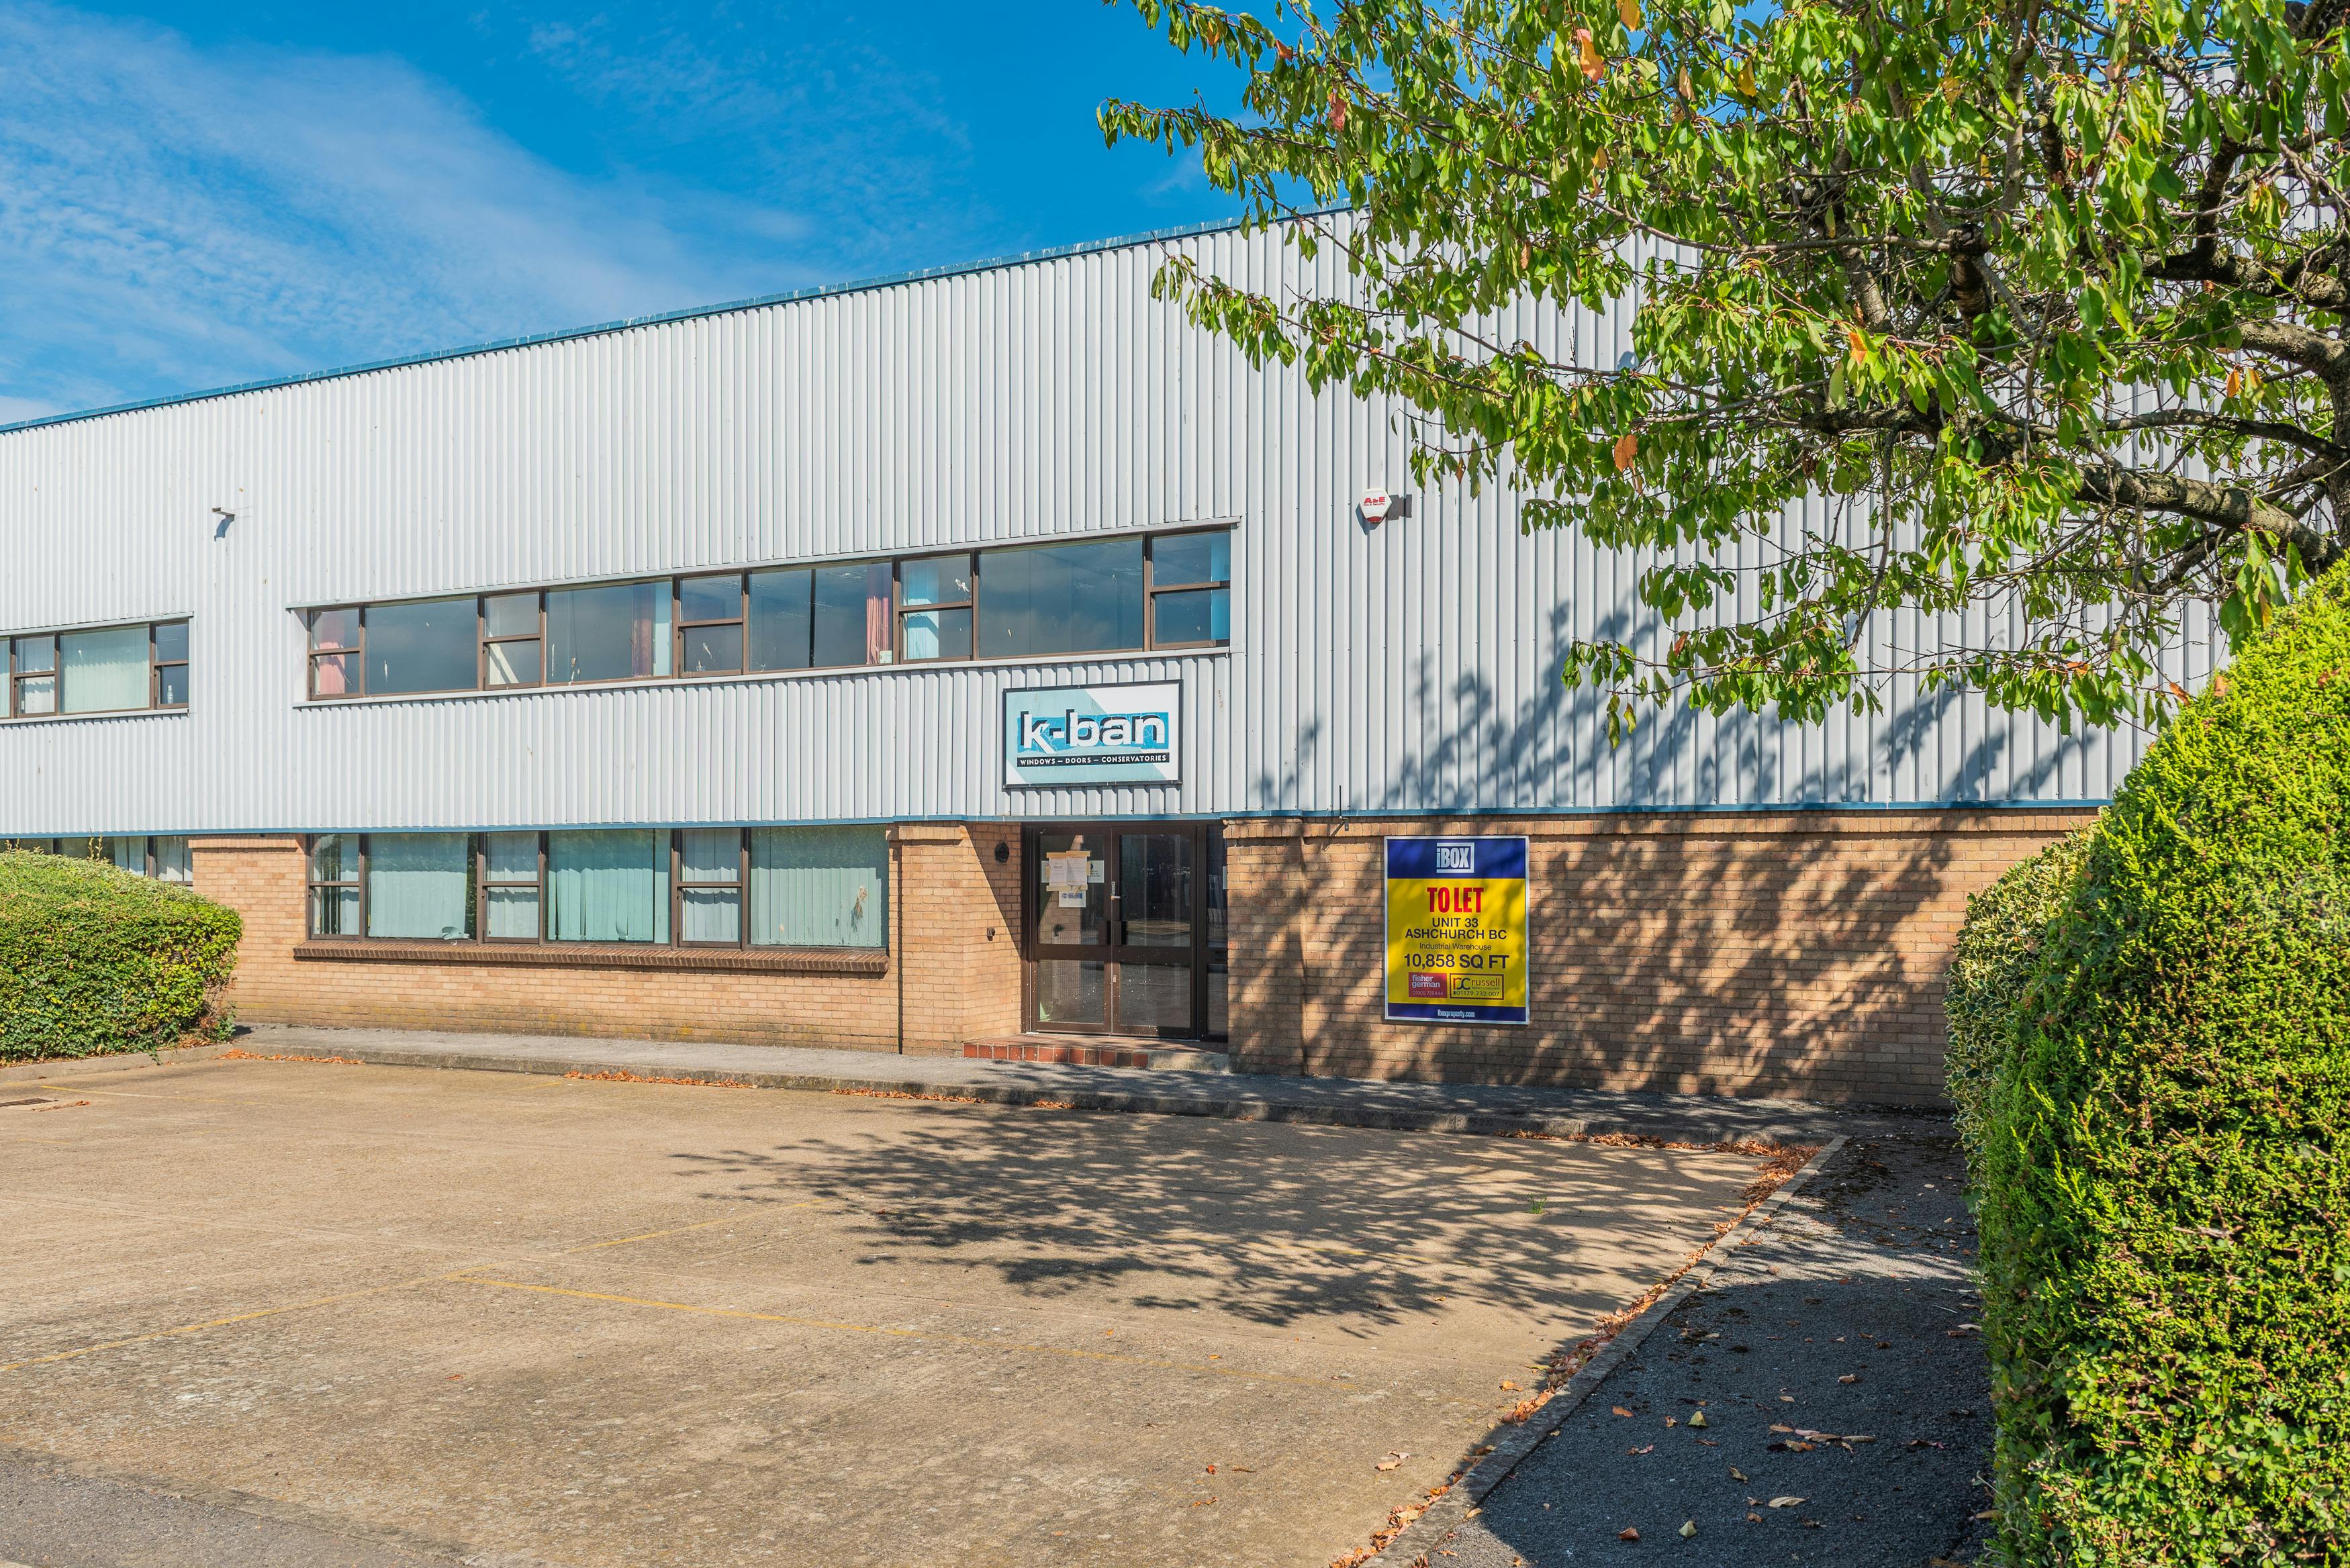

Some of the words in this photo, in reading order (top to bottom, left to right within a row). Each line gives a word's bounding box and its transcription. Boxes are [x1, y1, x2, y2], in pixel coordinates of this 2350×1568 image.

[1021, 709, 1165, 754] k-ban
[1101, 754, 1166, 763] CONSERVATORIES
[1436, 847, 1469, 868] iBOX
[1427, 887, 1450, 913] TO
[1454, 887, 1485, 913] LET
[1432, 918, 1461, 927] UNIT
[1464, 918, 1478, 928] 33
[1405, 929, 1484, 939] ASHCHURCH
[1489, 930, 1507, 940] BC
[1404, 953, 1455, 969] 10,858
[1460, 954, 1484, 969] SQ
[1489, 955, 1509, 969] FT
[1472, 977, 1500, 987] russell
